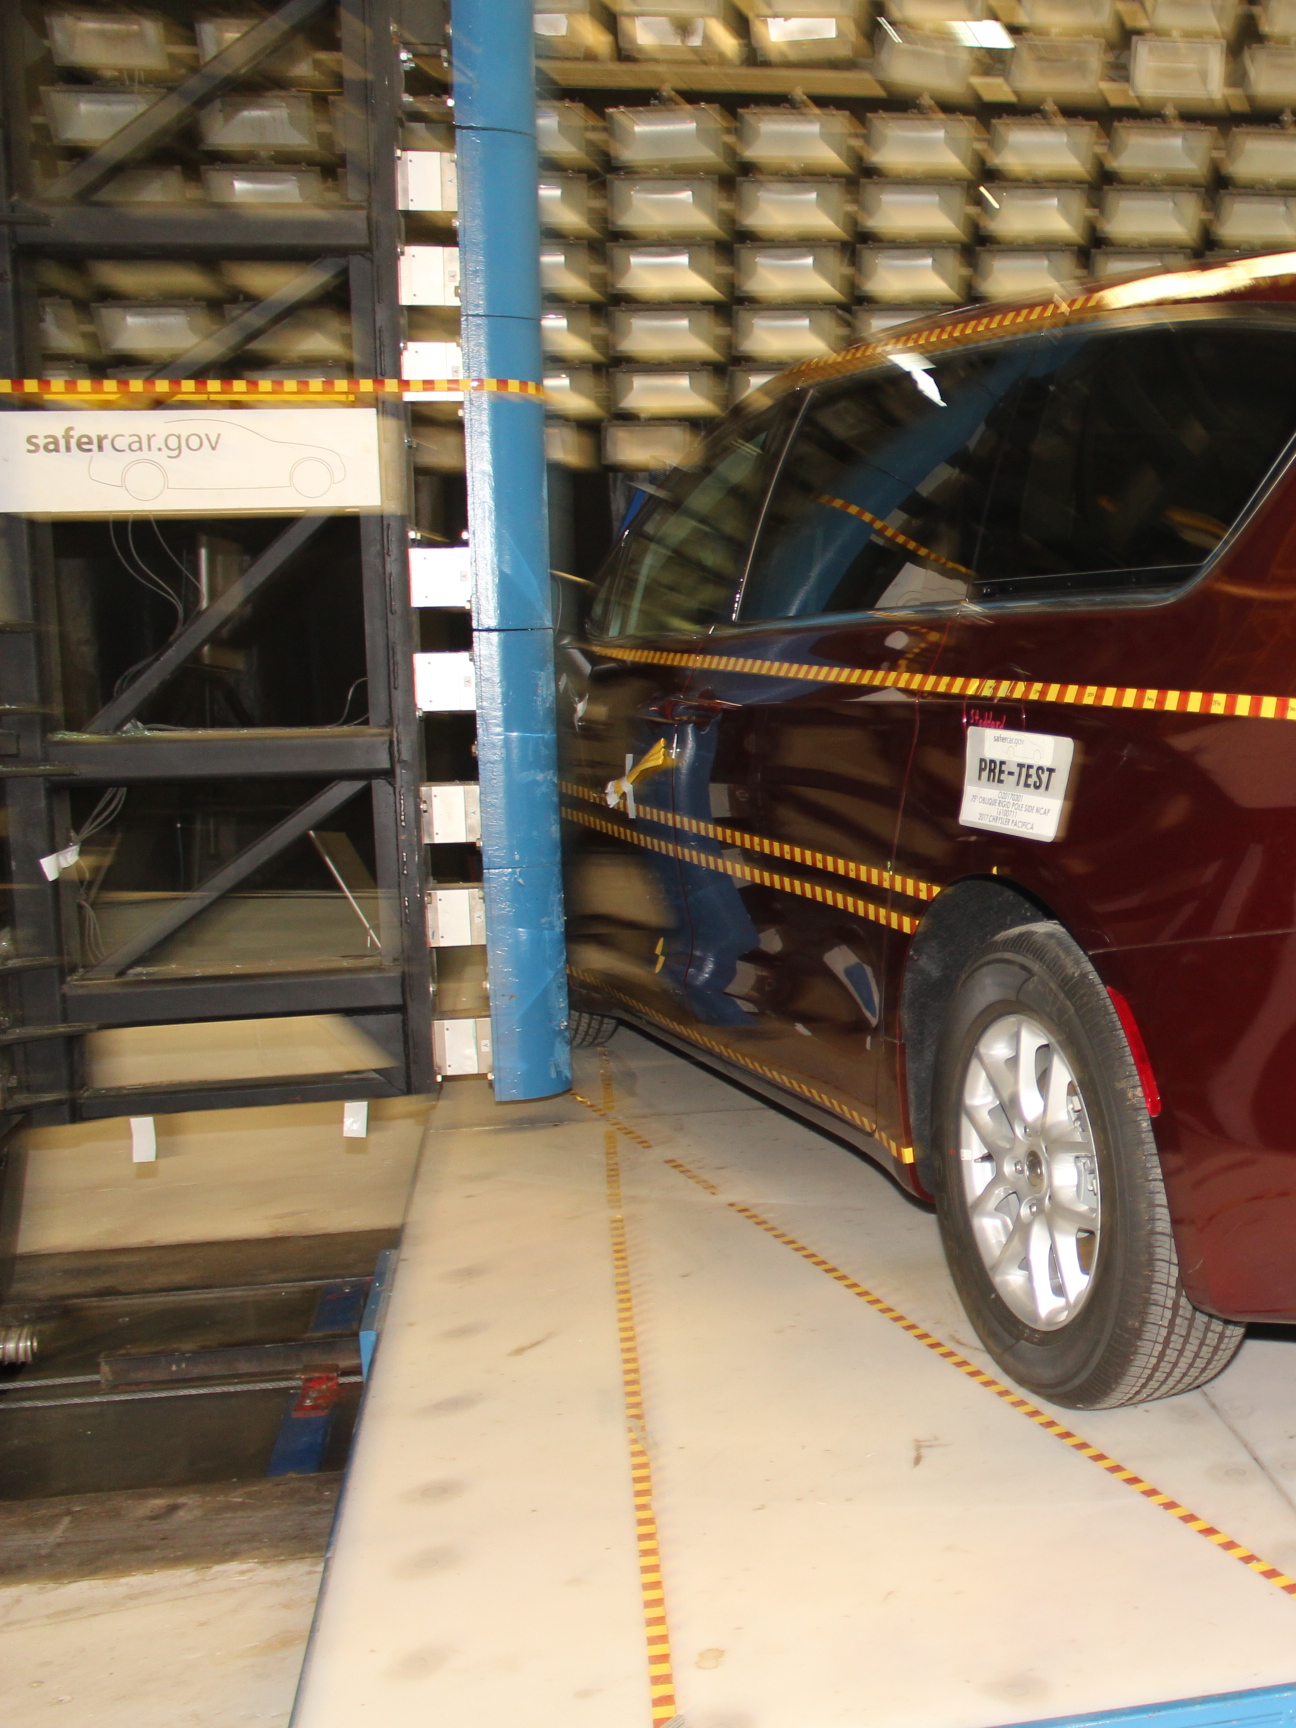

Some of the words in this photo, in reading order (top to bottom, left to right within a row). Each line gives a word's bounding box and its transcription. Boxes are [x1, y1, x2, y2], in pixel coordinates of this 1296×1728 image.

[25, 425, 222, 459] safercar.gov
[993, 734, 1024, 747] safercar.gov
[977, 758, 1056, 792] PRE-TEST
[979, 796, 998, 807] OBLIQUE
[998, 799, 1010, 809] RIGID
[1012, 802, 1024, 811] POLE
[1025, 804, 1035, 813] SIDE
[1036, 806, 1051, 816] NCAP
[978, 812, 989, 821] 2017
[989, 814, 1010, 826] CHRYSLER
[1011, 818, 1034, 831] PACIFICA
